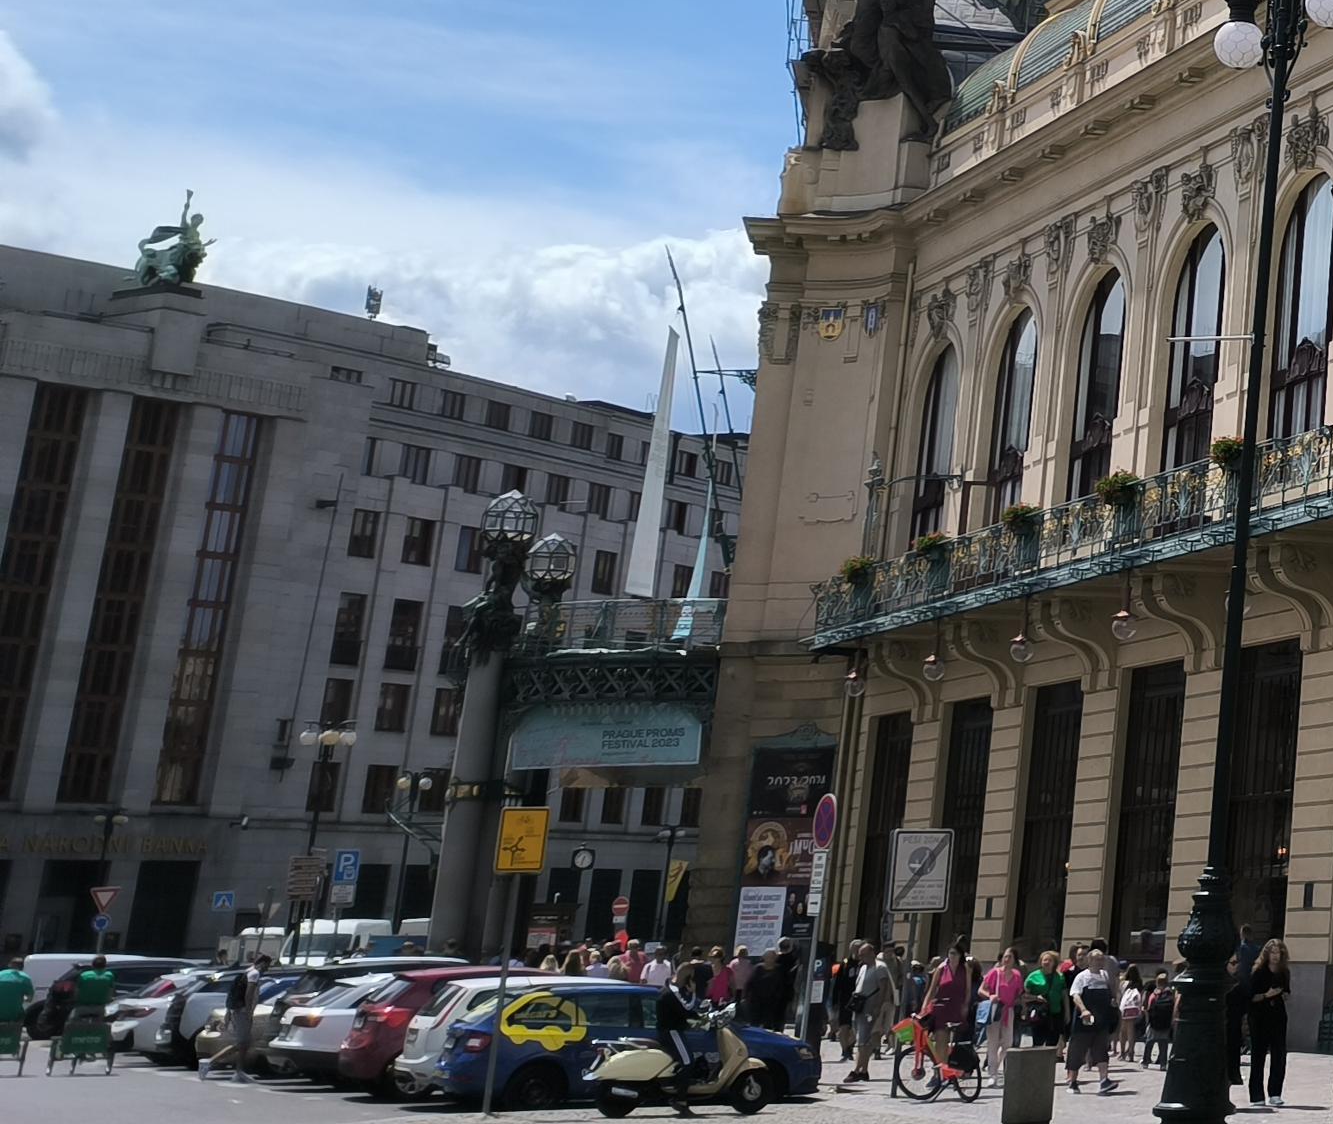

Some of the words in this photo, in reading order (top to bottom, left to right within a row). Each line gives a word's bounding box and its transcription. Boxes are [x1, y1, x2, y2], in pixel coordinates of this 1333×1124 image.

[602, 728, 645, 739] PRAGUE
[646, 727, 685, 738] PROMS
[601, 739, 649, 749] FESTIVAL
[651, 738, 680, 748] 2023
[339, 853, 356, 873] P
